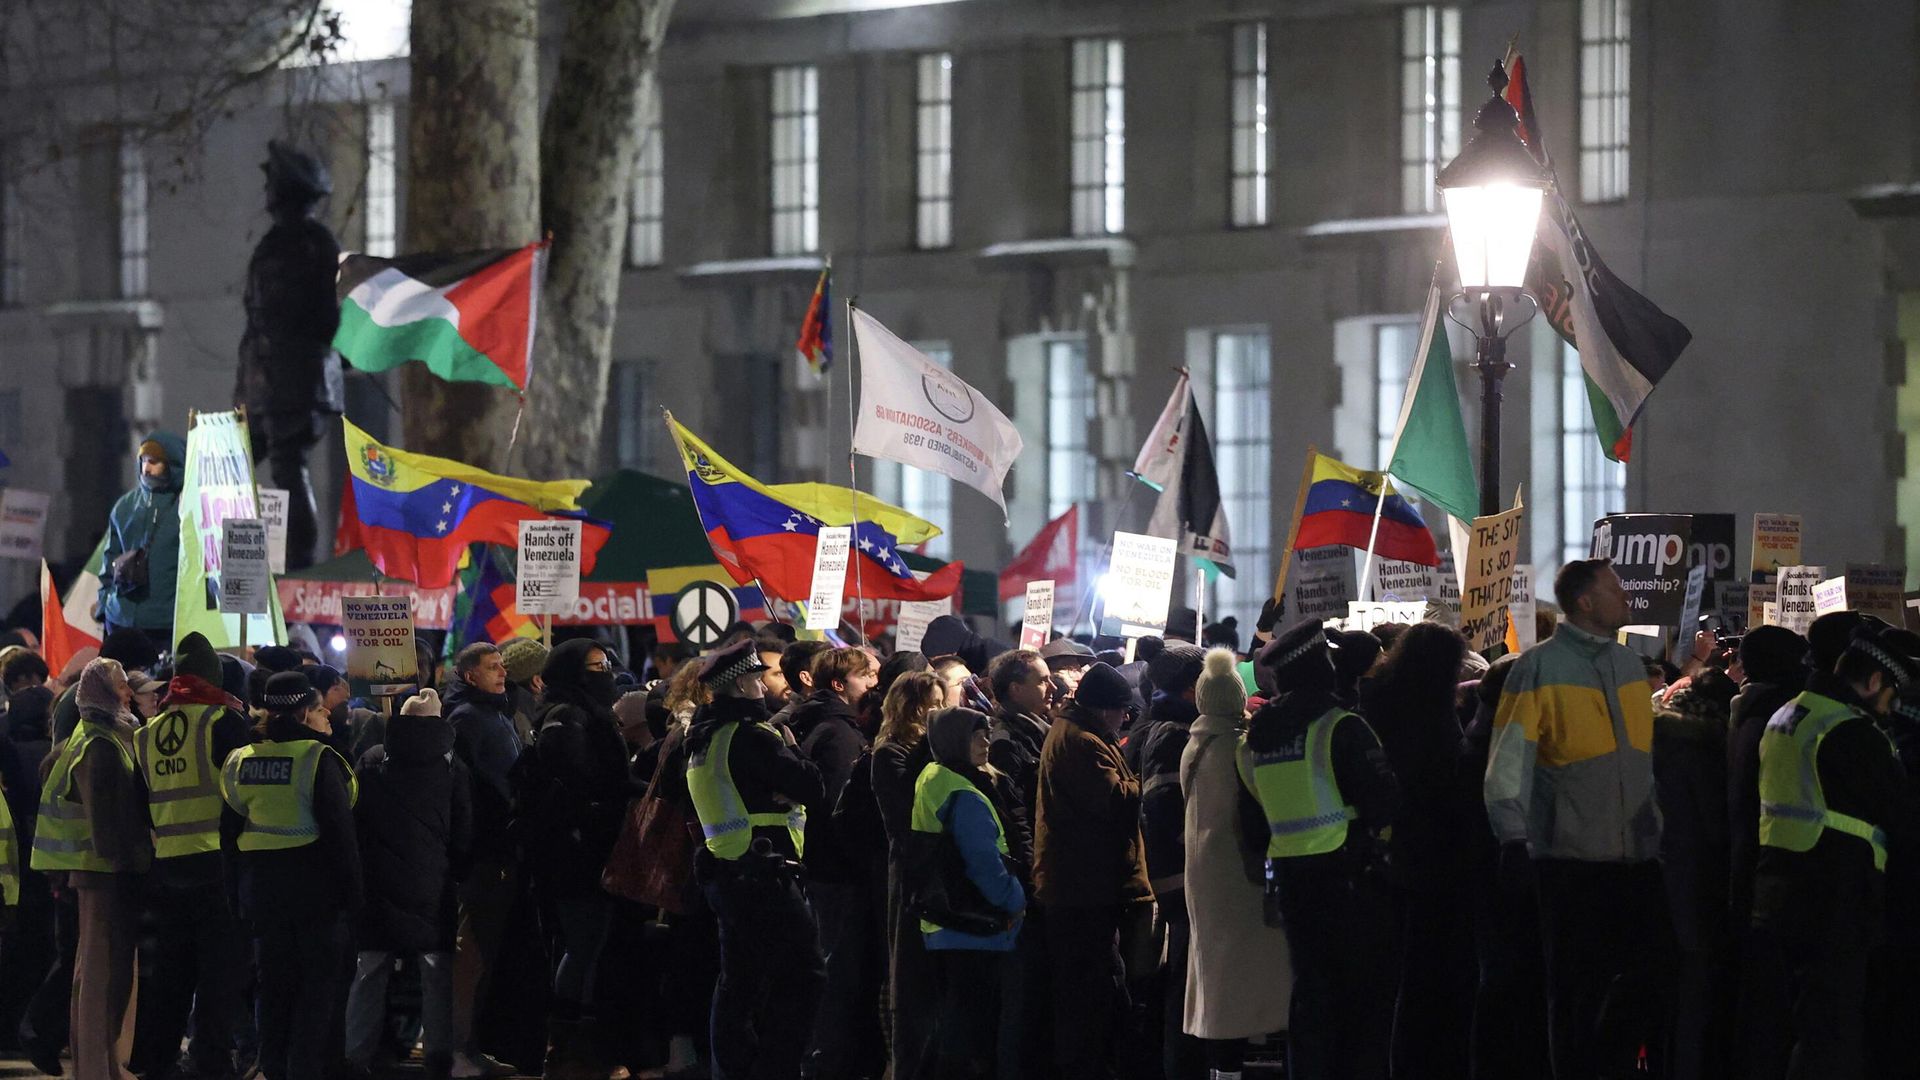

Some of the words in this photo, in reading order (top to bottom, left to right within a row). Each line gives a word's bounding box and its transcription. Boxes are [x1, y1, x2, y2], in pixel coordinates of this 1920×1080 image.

[268, 501, 282, 513] off
[228, 530, 252, 545] Hands
[253, 530, 265, 545] off
[525, 533, 555, 547] Hands
[558, 533, 574, 547] off
[1476, 523, 1500, 548] THE
[1120, 540, 1133, 549] NO
[1593, 525, 1684, 576] Tump
[227, 545, 265, 560] Venezuela
[524, 548, 574, 561] Venezuela
[1116, 564, 1131, 574] NO
[1379, 561, 1411, 576] Hands
[1480, 558, 1493, 577] IS
[1497, 550, 1510, 571] SO
[1380, 575, 1432, 590] Venezuela
[1513, 577, 1528, 588] off
[1620, 579, 1680, 593] lationship?
[1782, 581, 1807, 596] Hands
[1440, 585, 1460, 598] Han
[347, 603, 361, 612] NO
[364, 603, 390, 612] WAR
[392, 603, 407, 611] ON
[1634, 597, 1649, 609] No
[1781, 597, 1817, 613] Venezue
[347, 612, 409, 621] VENEZUELA
[349, 628, 366, 637] NO
[369, 628, 409, 637] BLOOD
[356, 638, 379, 648] FOR
[382, 638, 404, 647] OIL
[155, 757, 187, 777] CND
[242, 760, 290, 781] POLICE
